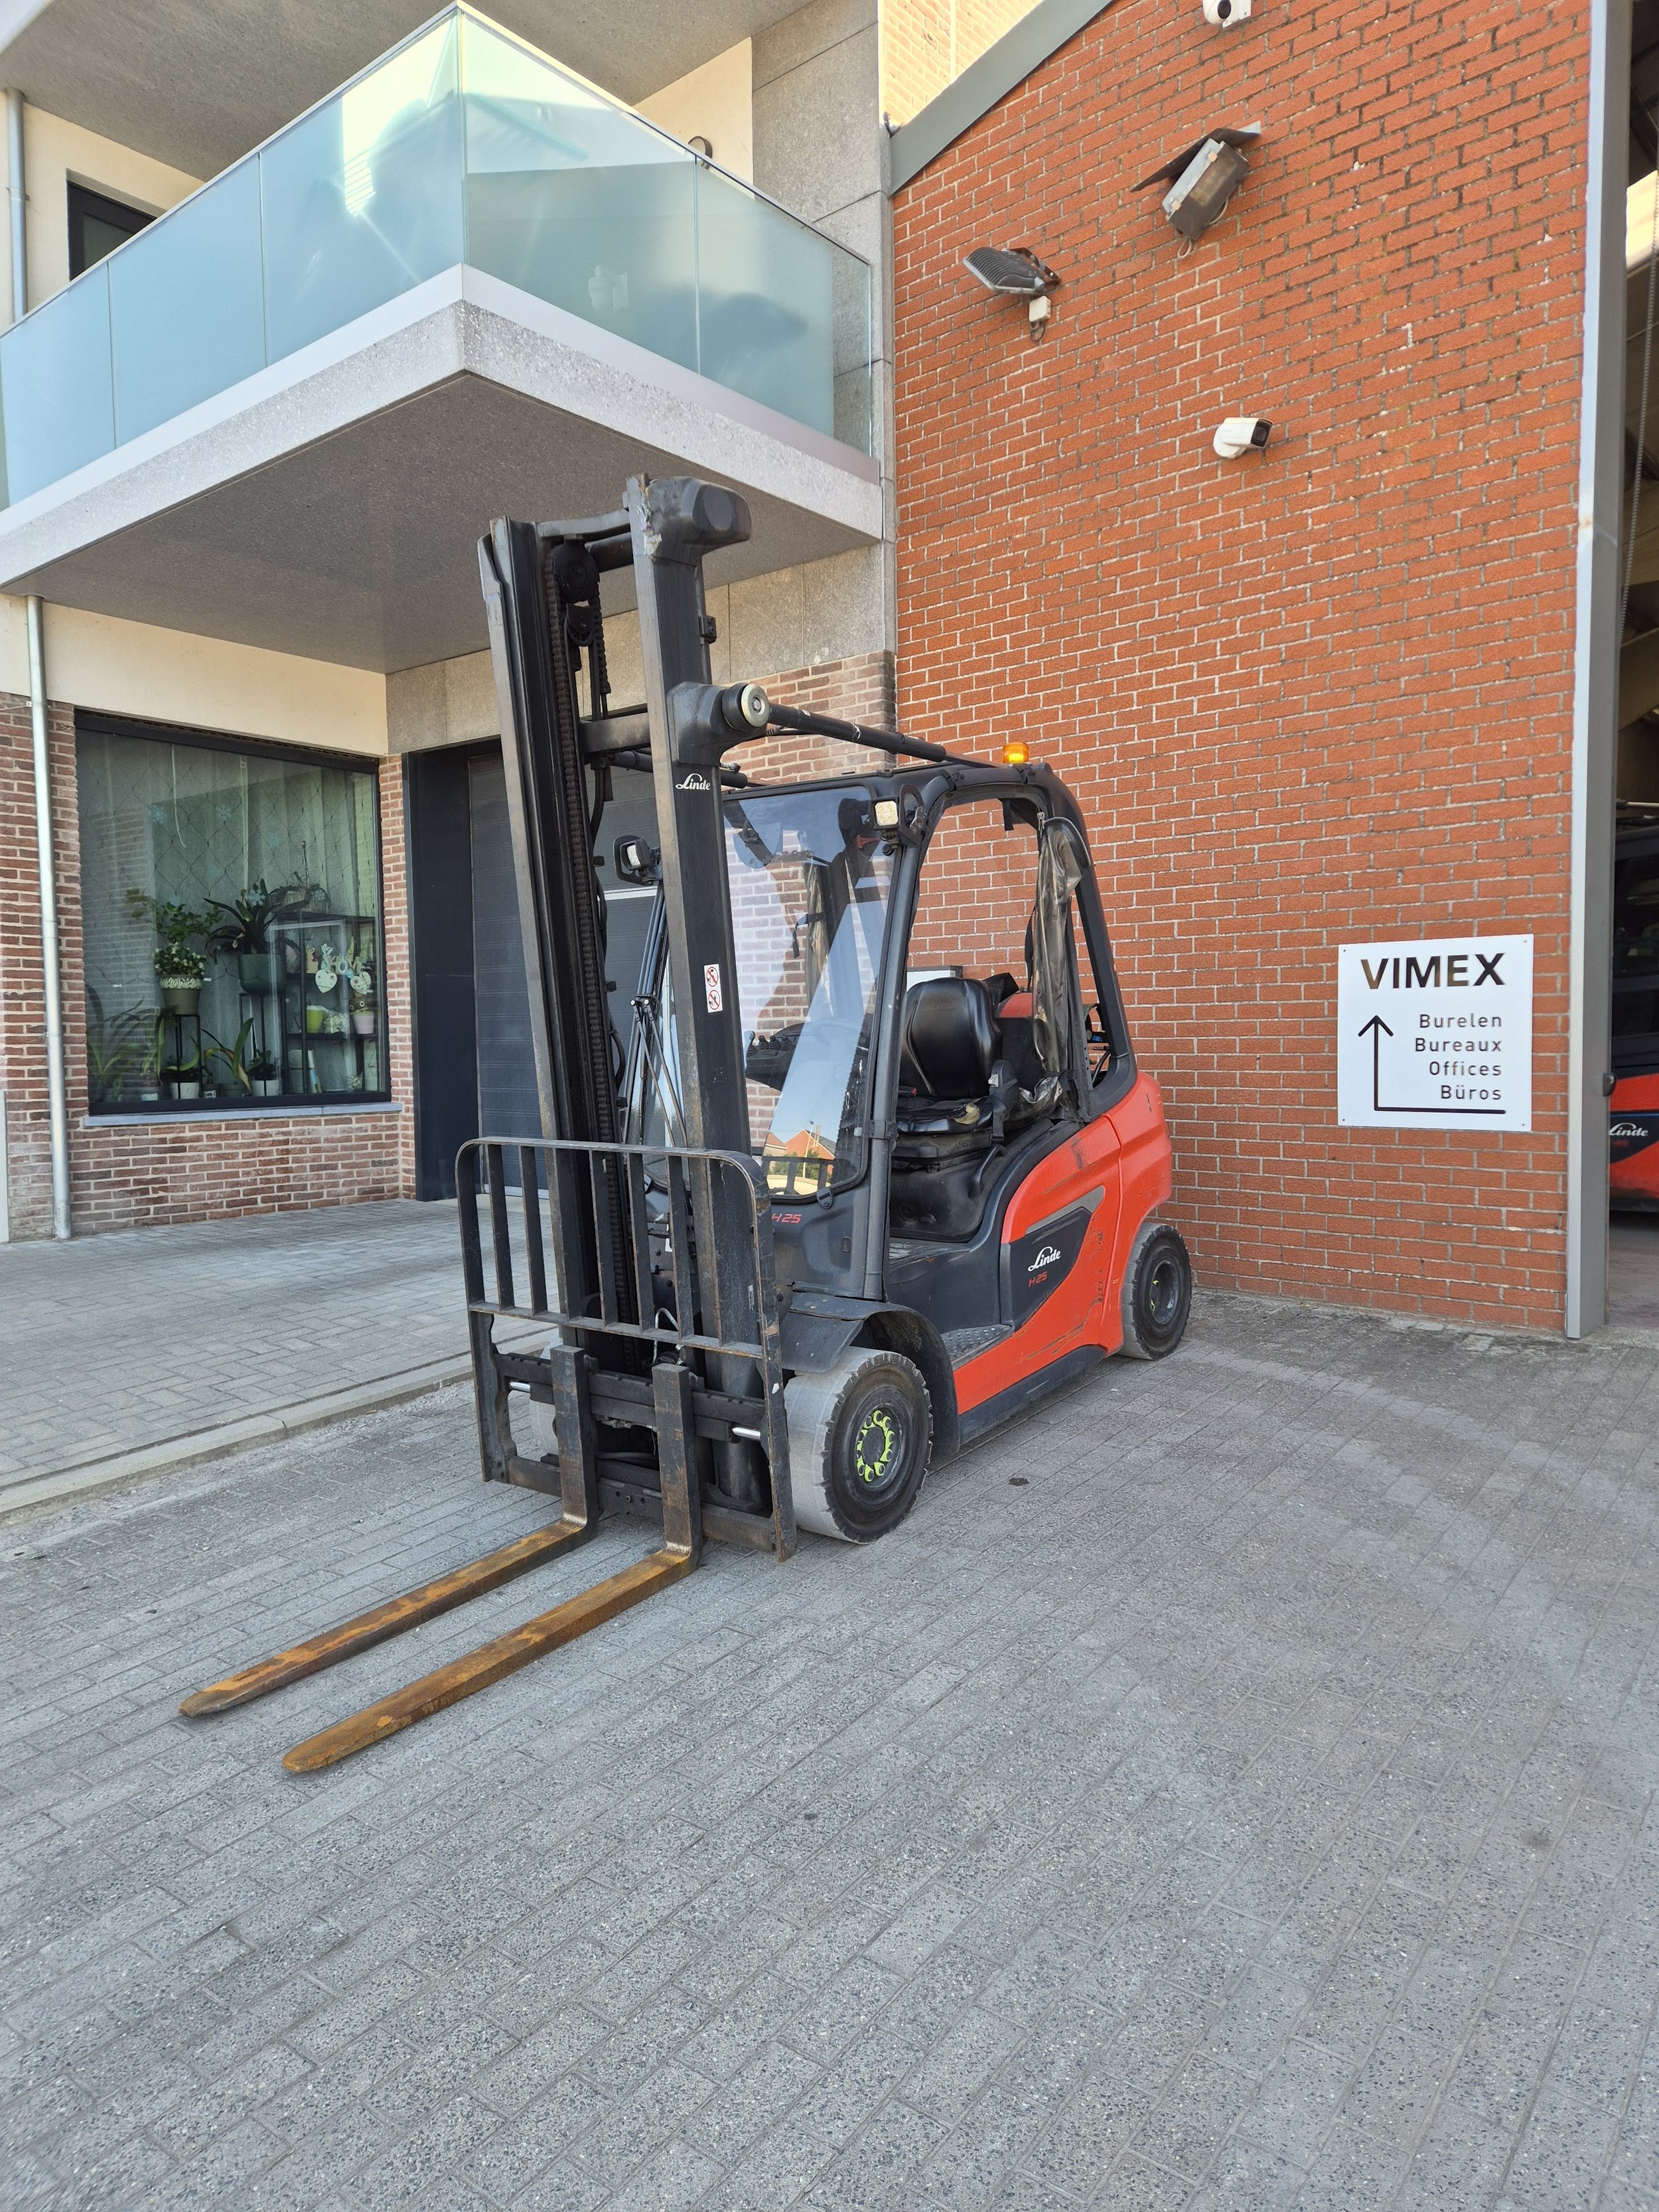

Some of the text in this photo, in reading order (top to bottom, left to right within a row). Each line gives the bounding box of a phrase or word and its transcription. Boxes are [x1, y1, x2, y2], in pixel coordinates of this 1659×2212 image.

[676, 773, 711, 790] Linde
[1360, 952, 1506, 990] VIMEX
[1419, 1013, 1502, 1028] Burelen
[1415, 1037, 1502, 1052] Bureaux
[1429, 1061, 1502, 1076] Offices
[1441, 1084, 1502, 1100] Büros
[1609, 1122, 1649, 1136] Linde
[1028, 1246, 1061, 1272] Linde
